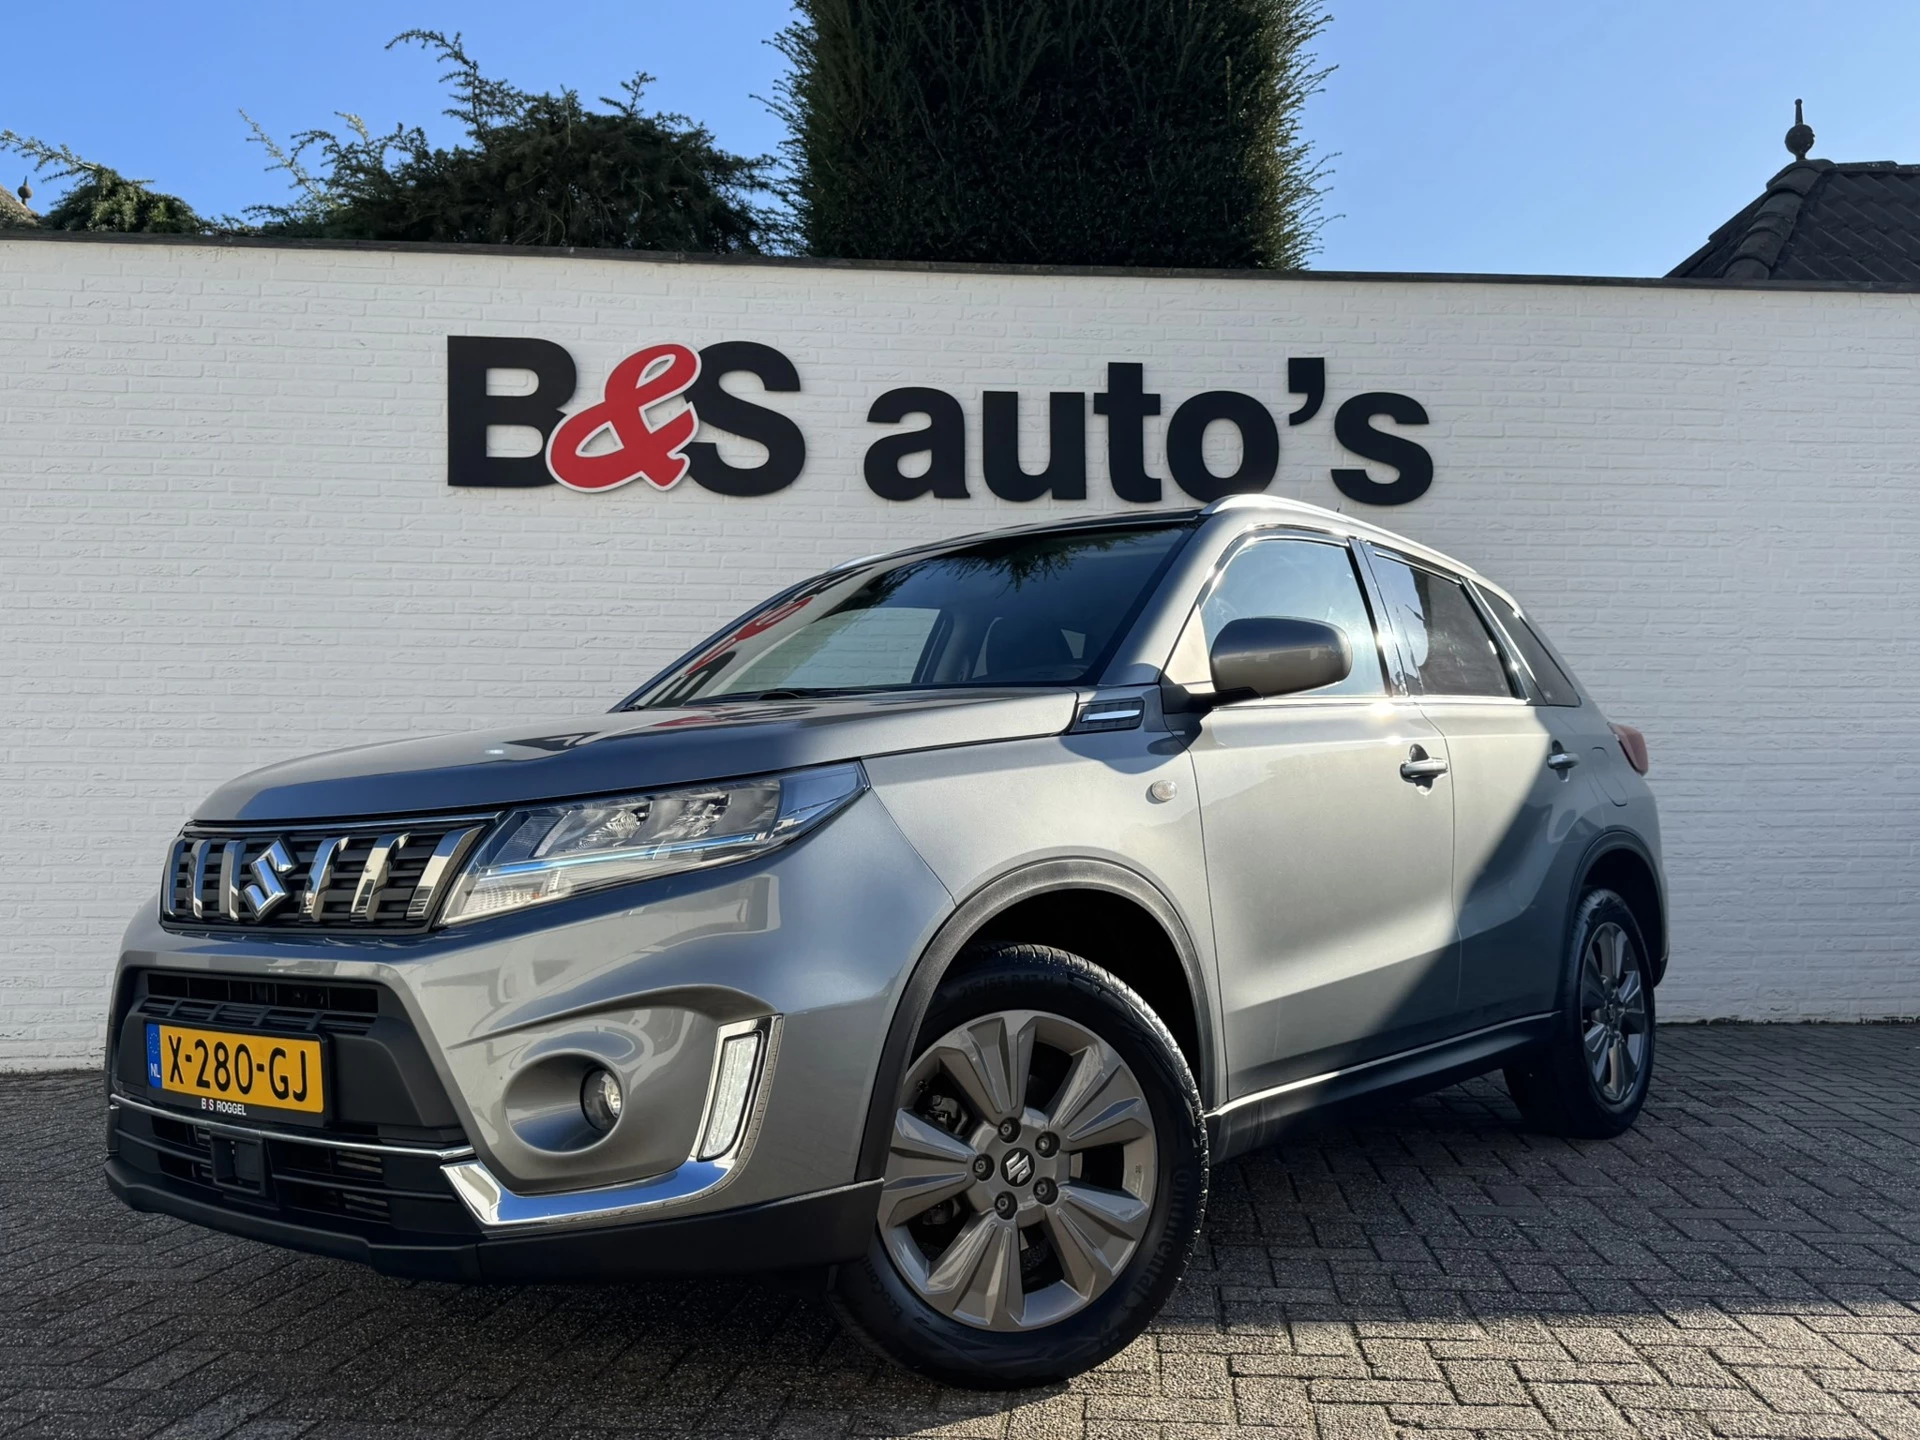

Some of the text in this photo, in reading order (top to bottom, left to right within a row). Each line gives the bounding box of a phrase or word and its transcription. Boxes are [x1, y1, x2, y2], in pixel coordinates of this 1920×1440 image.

[447, 334, 1434, 507] B&S auto's
[150, 1063, 161, 1079] NL
[167, 1034, 308, 1103] X-280-GJ
[216, 1100, 247, 1116] ROGGEL
